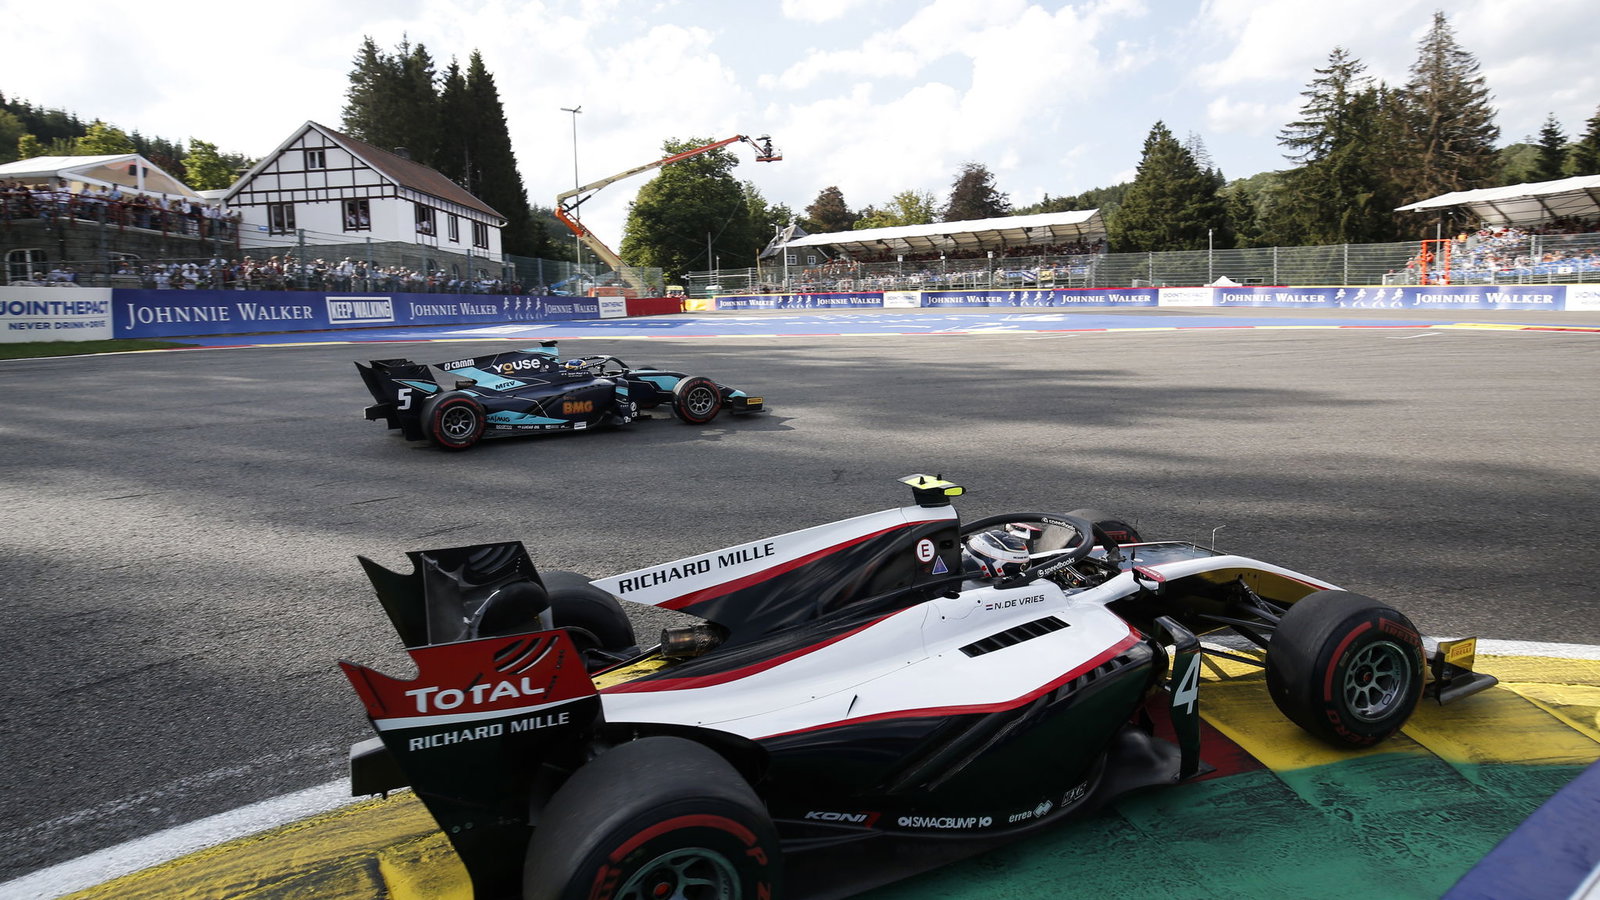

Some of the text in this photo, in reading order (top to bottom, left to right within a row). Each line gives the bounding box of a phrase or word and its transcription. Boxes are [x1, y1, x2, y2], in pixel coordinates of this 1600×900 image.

[816, 298, 848, 306] JOHNNIE
[928, 295, 1003, 306] JOHNNIE WALKER
[1060, 293, 1151, 305] JOHNNIE WALKER
[1220, 292, 1272, 304] JOHNNIE
[1275, 292, 1326, 304] WALKER
[1413, 292, 1554, 306] JOHNNIE WALKER
[125, 303, 313, 330] JOHNNIE WALKER
[330, 301, 390, 319] KEEP WALKING
[410, 302, 498, 320] JOHNNIE WALKER
[8, 321, 51, 330] NEVER
[396, 388, 413, 410] 5
[563, 401, 593, 415] BMG
[921, 543, 931, 558] E
[618, 542, 775, 594] RICHARD MILLE
[1044, 556, 1076, 575] speedbooks
[1019, 594, 1045, 606] VRIES
[1173, 654, 1200, 715] 4
[405, 677, 546, 714] TOTAL
[408, 711, 570, 752] RICHARD MILLE
[804, 810, 866, 823] KONI
